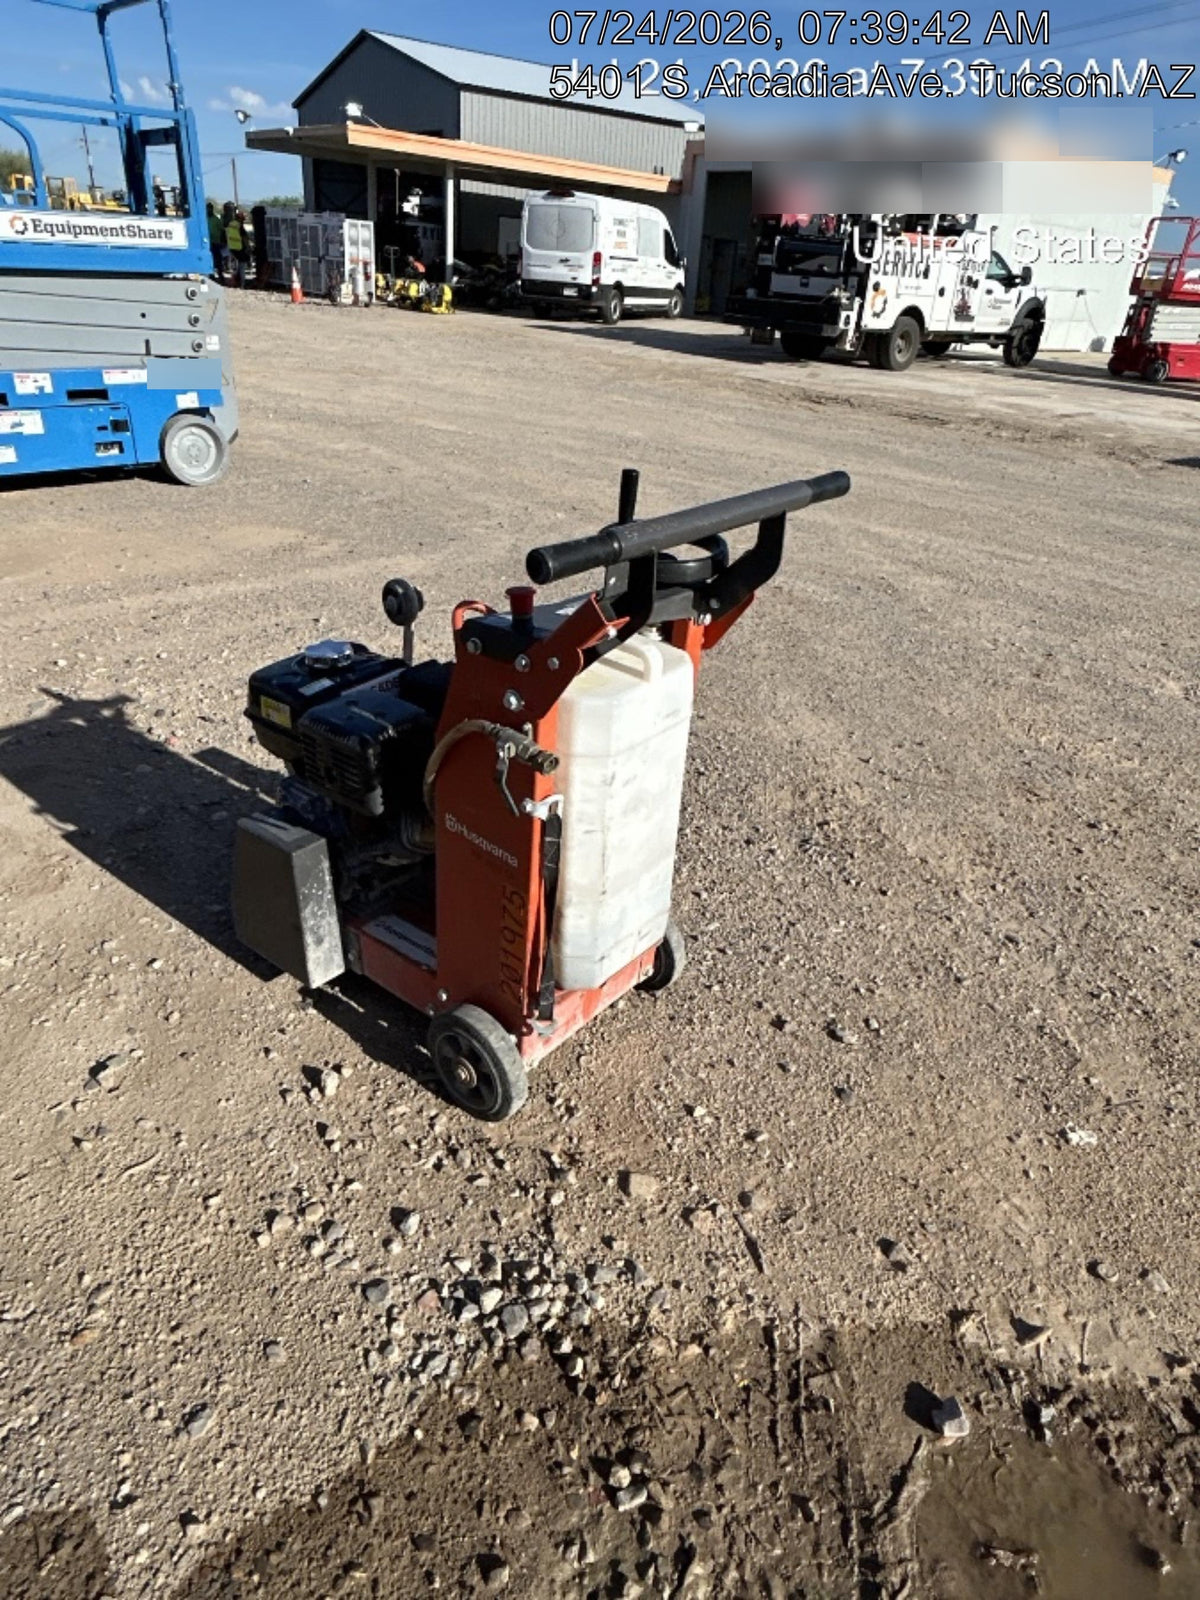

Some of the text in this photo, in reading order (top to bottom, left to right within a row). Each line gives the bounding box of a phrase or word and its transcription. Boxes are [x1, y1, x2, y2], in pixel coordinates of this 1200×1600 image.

[30, 217, 174, 240] EquipmentShare
[457, 822, 519, 869] Husqvarna
[499, 885, 526, 1004] 201975
